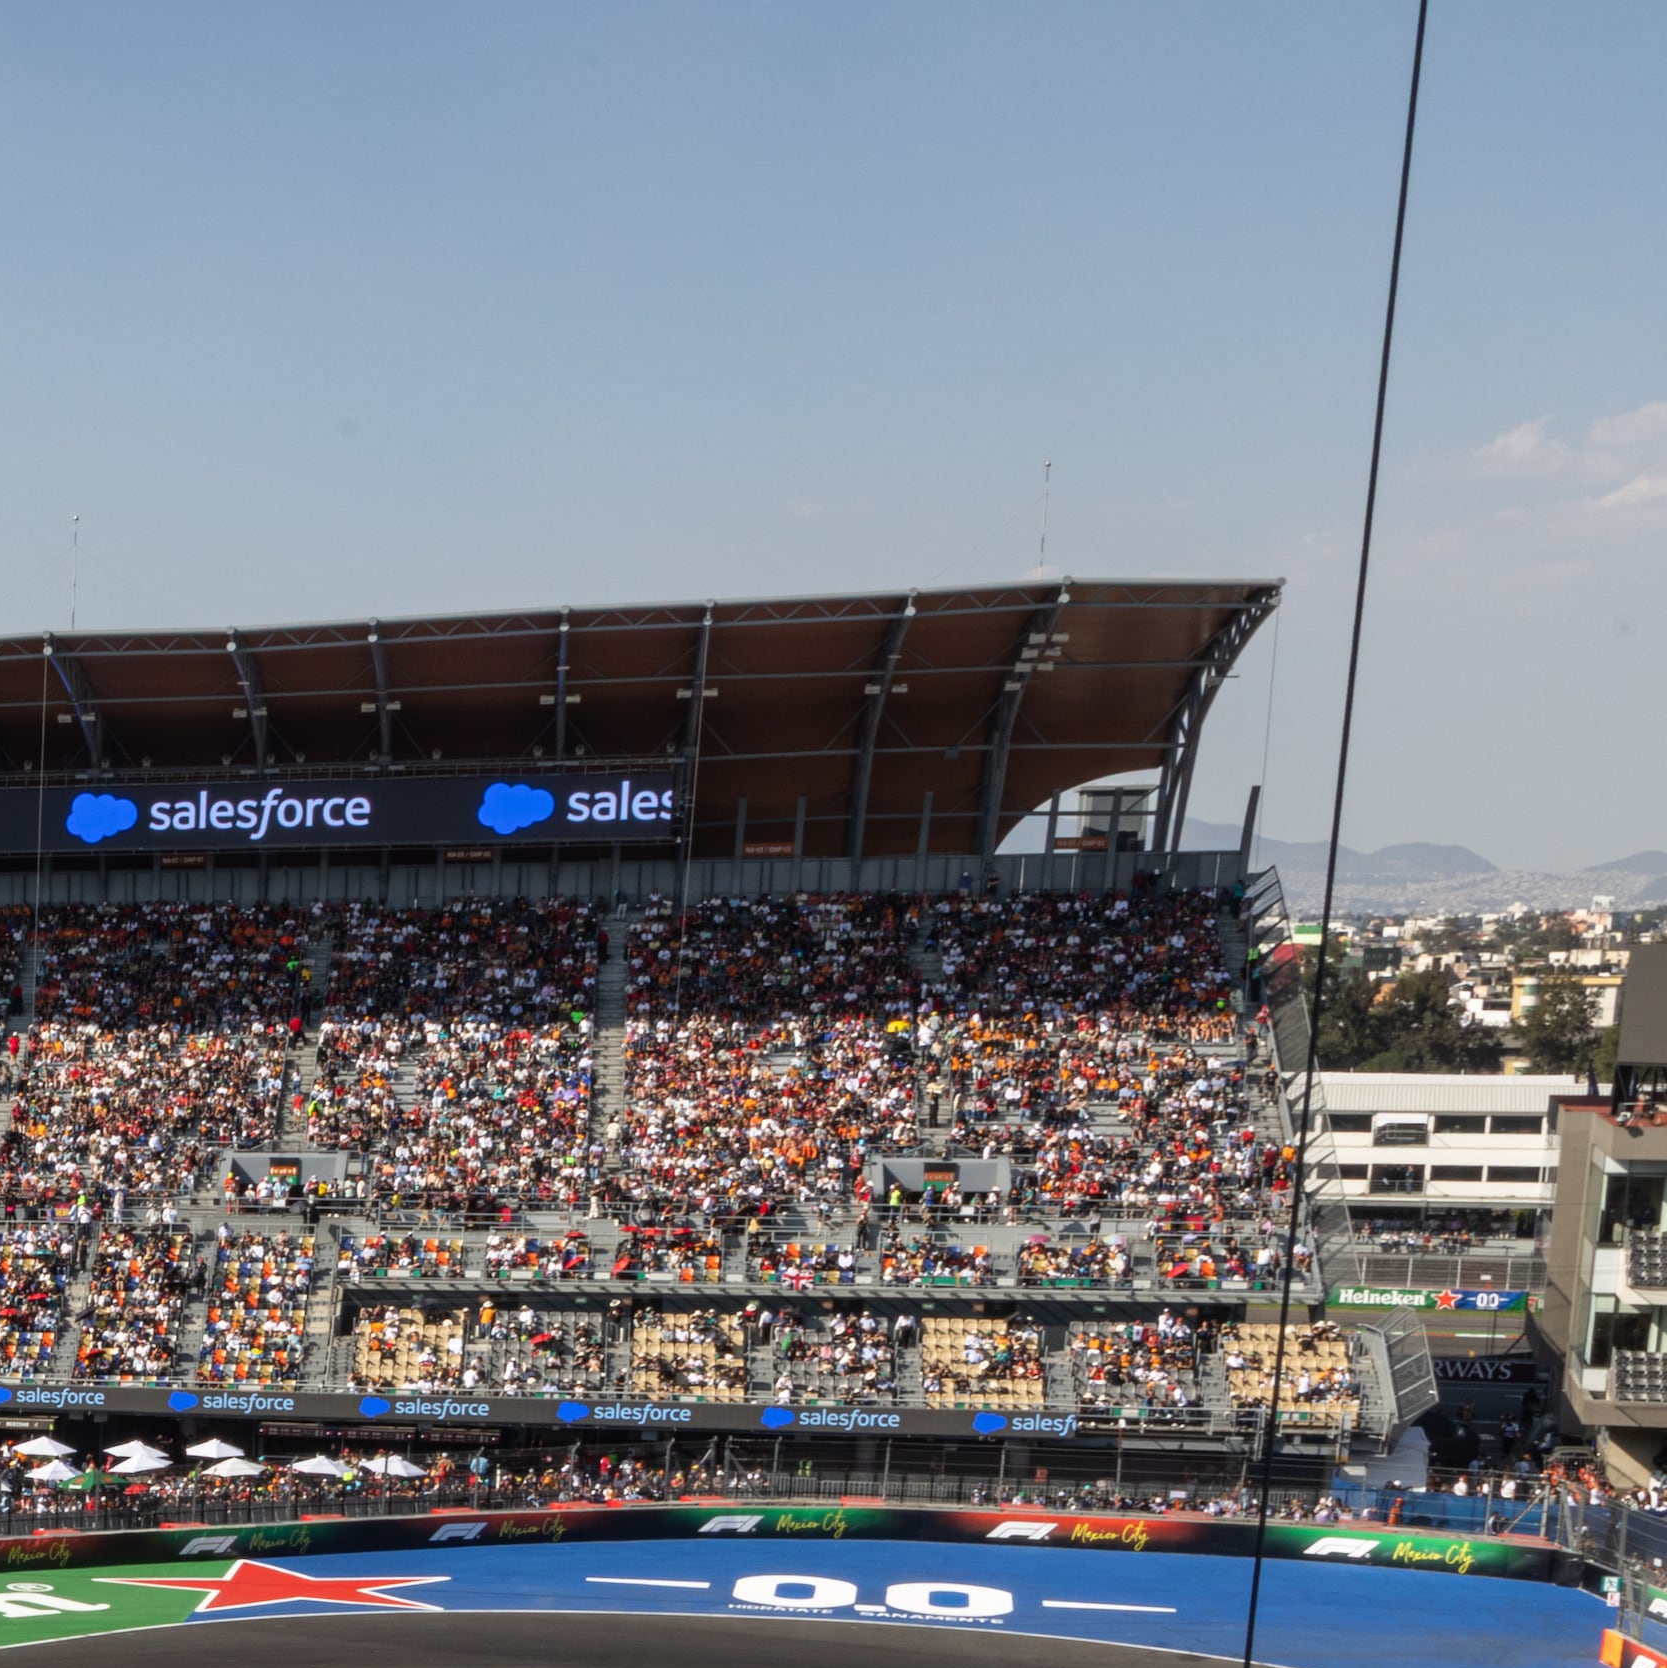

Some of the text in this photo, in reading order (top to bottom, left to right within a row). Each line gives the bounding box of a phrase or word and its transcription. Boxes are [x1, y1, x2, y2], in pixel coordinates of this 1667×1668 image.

[150, 788, 371, 839] salesforce
[1339, 1289, 1423, 1306] Heineken
[16, 1387, 105, 1407] salesforce
[203, 1393, 295, 1414] salesforce
[395, 1398, 490, 1419] salesforce
[593, 1403, 692, 1424] salesforce
[799, 1409, 901, 1430] salesforce
[500, 1521, 541, 1538] Mexico
[543, 1514, 566, 1542] City
[777, 1515, 820, 1533] Mexico
[822, 1509, 848, 1539] City
[1071, 1523, 1117, 1541] Mexico
[1121, 1520, 1150, 1551] City
[8, 1545, 47, 1565] Mexico
[49, 1538, 71, 1566] City
[250, 1533, 287, 1550] Mexico
[289, 1525, 311, 1554] City
[1392, 1543, 1441, 1561] Mexico
[1444, 1542, 1475, 1575] City
[732, 1574, 1014, 1618] 0.0
